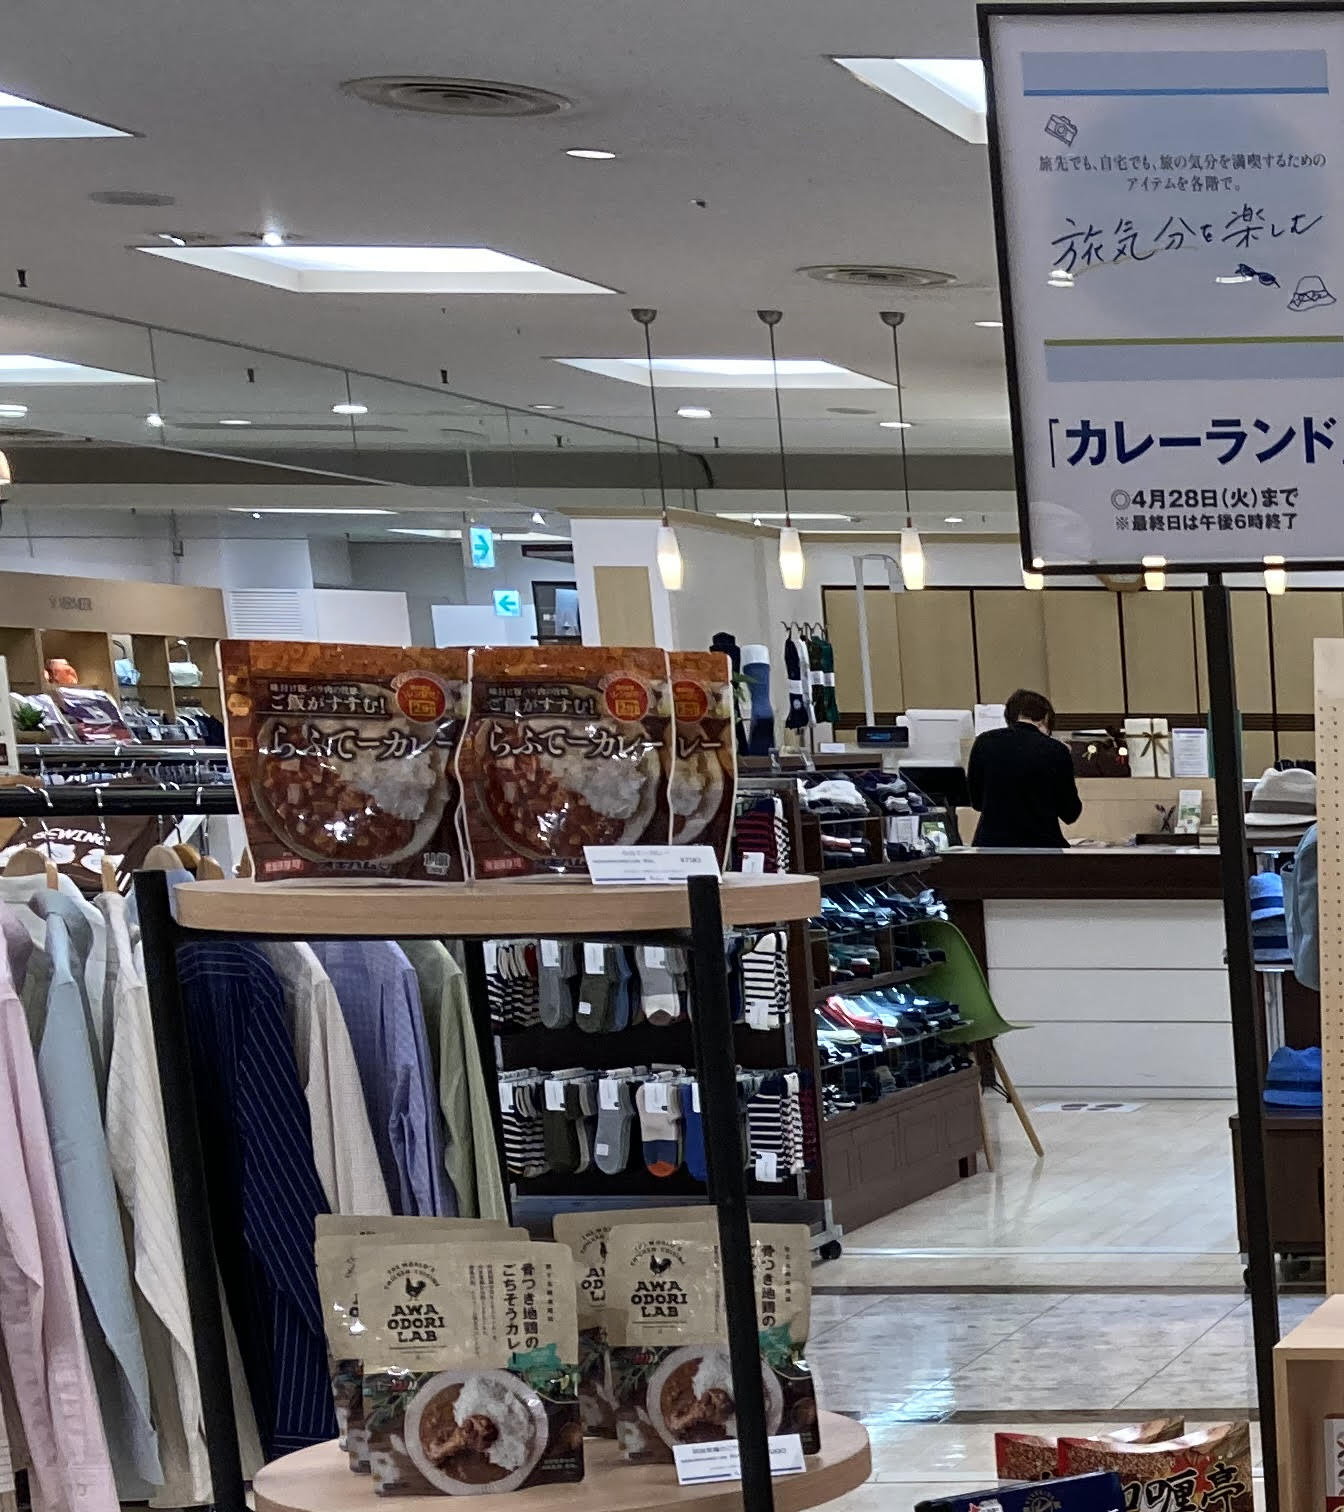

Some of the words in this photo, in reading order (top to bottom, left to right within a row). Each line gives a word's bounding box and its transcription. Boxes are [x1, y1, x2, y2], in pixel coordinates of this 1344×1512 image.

[1126, 174, 1242, 193] アイテムを各階で。
[1051, 203, 1323, 273] 旅気分を楽しむ
[272, 724, 453, 761] らふてーカレー
[489, 723, 663, 756] らふてーカレー
[635, 1280, 683, 1292] AWA
[631, 1294, 688, 1305] ODORI
[391, 1304, 439, 1317] AWA
[503, 1264, 520, 1364] ごちそうカレー
[641, 1306, 679, 1317] LAB
[387, 1317, 445, 1330] ODORI
[398, 1331, 438, 1343] LAB
